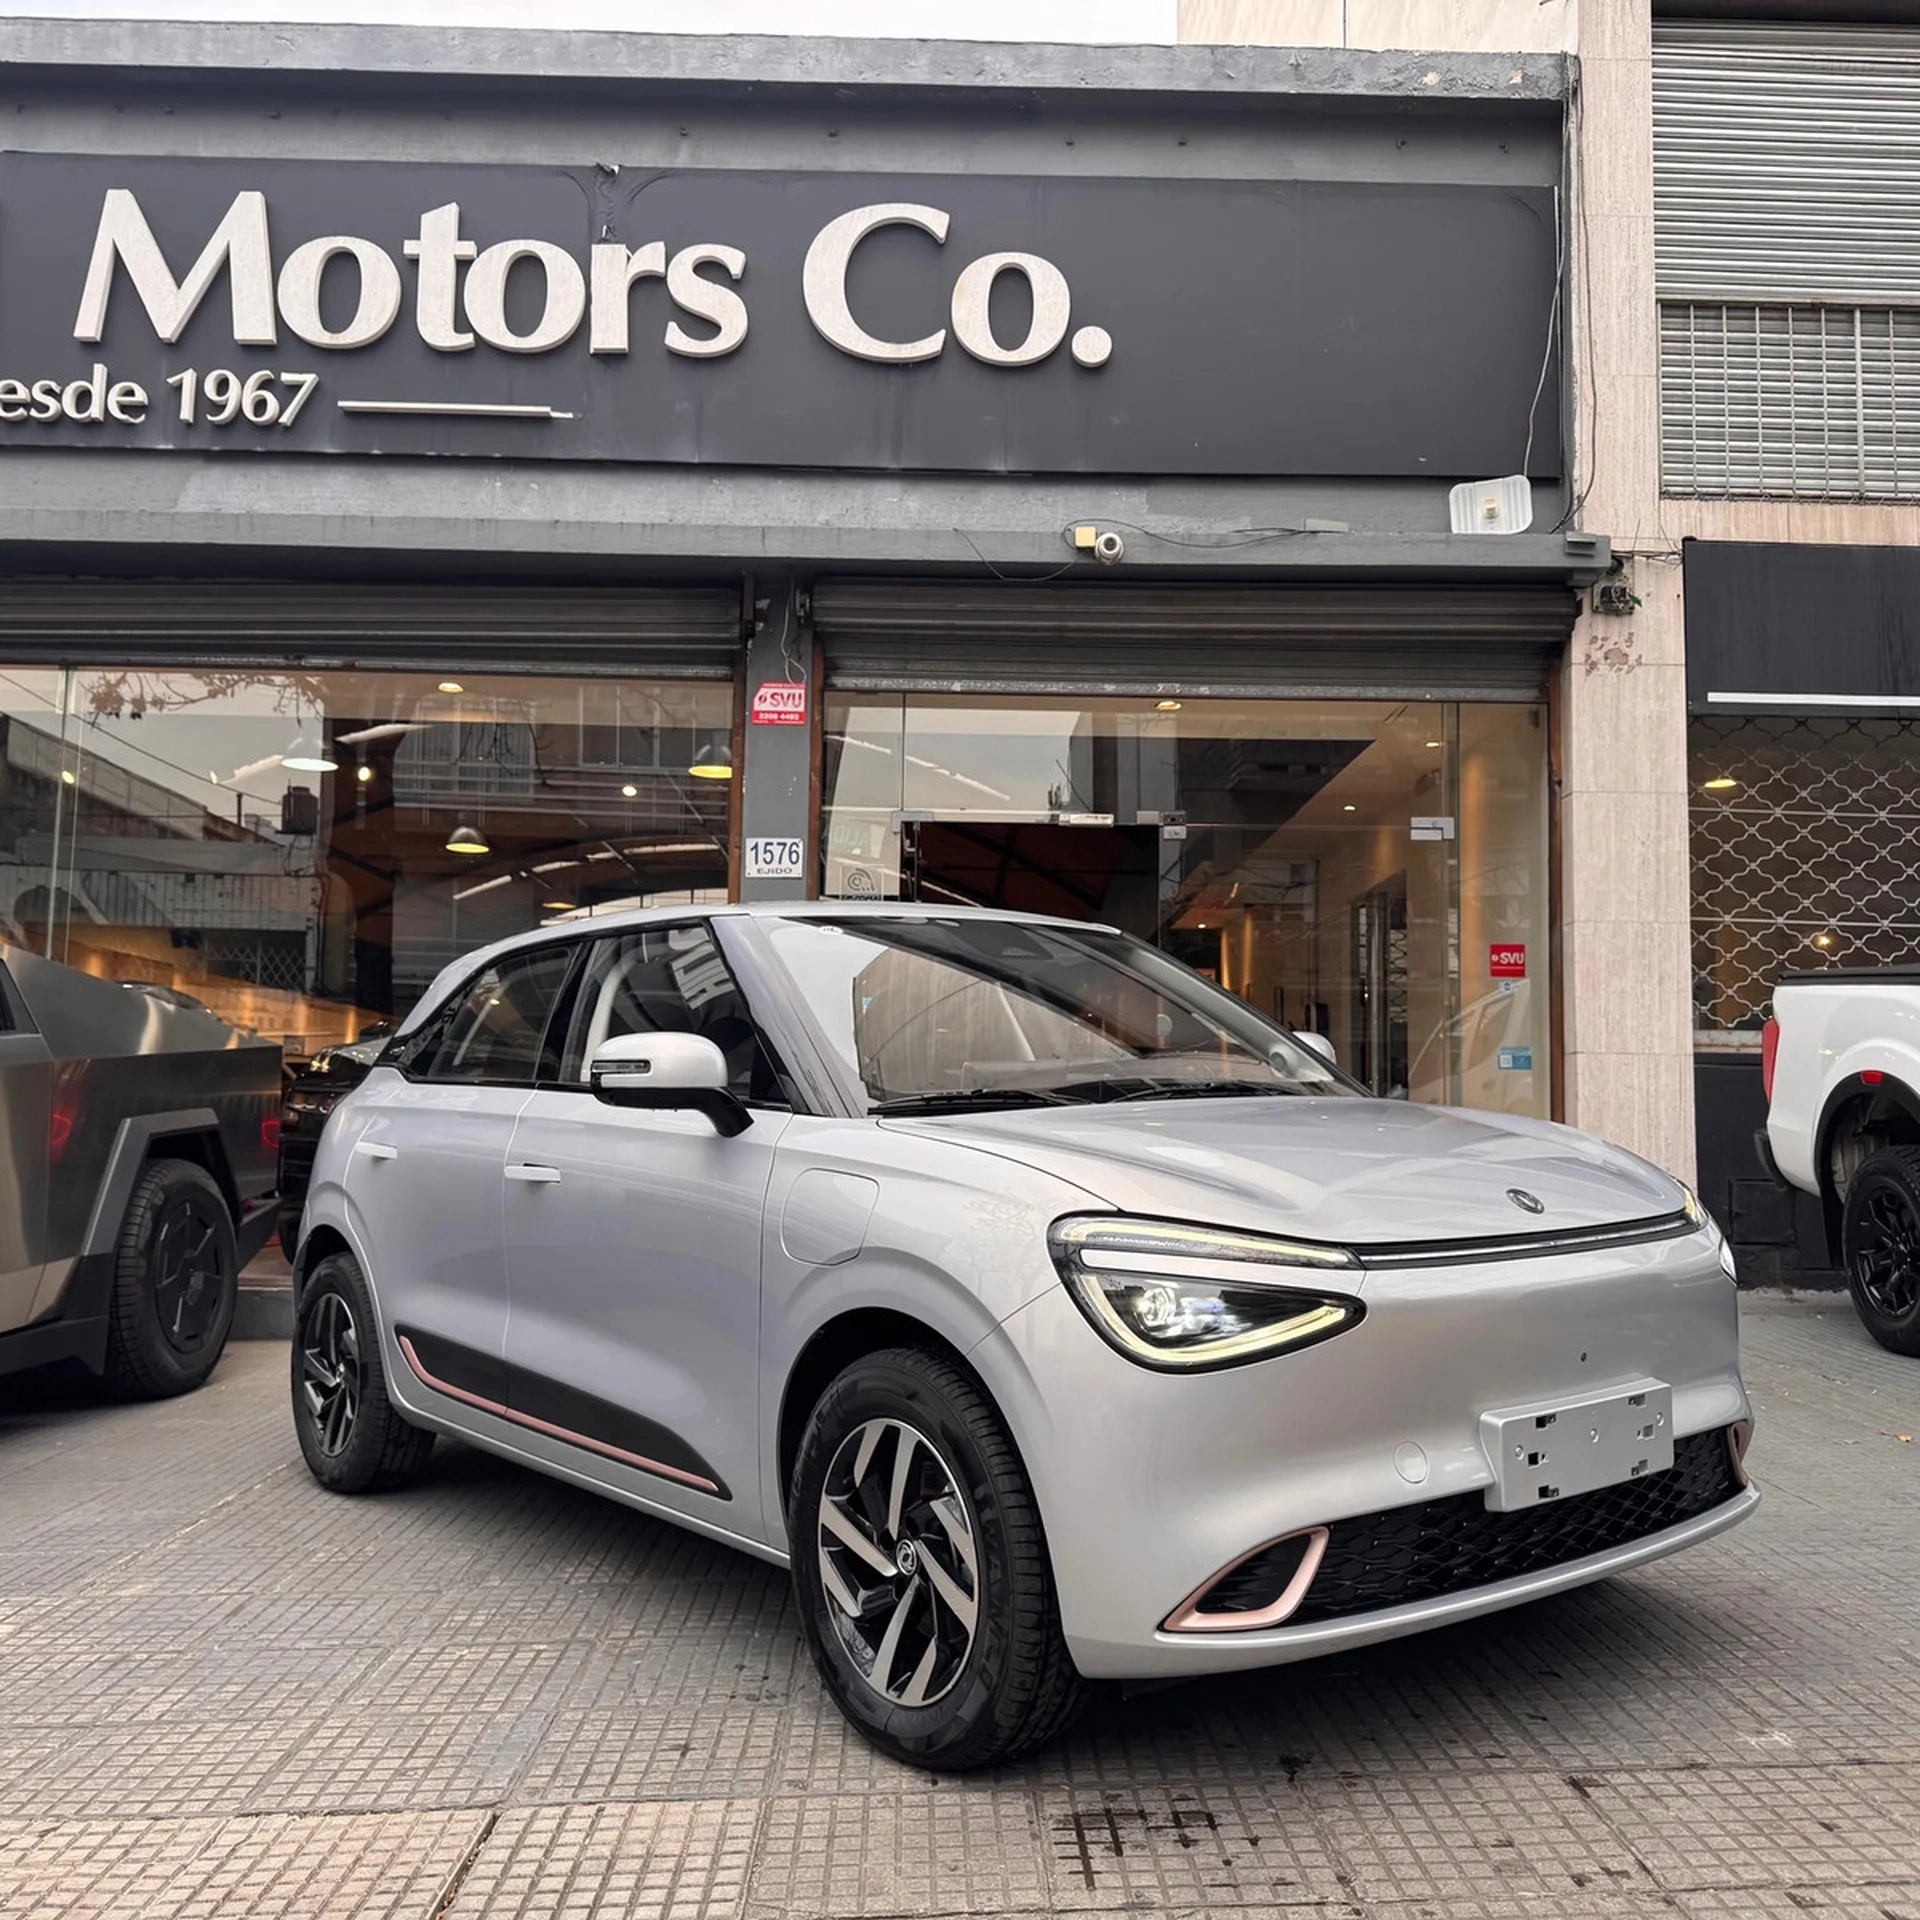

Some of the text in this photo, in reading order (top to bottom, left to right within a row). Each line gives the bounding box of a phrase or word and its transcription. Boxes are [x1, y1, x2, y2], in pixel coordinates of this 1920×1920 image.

[73, 188, 1113, 367] Motors Co.
[166, 368, 320, 427] 1967
[769, 691, 802, 708] SVU
[750, 841, 800, 865] 1576
[757, 867, 793, 875] EJIDO
[1499, 952, 1524, 965] SVU
